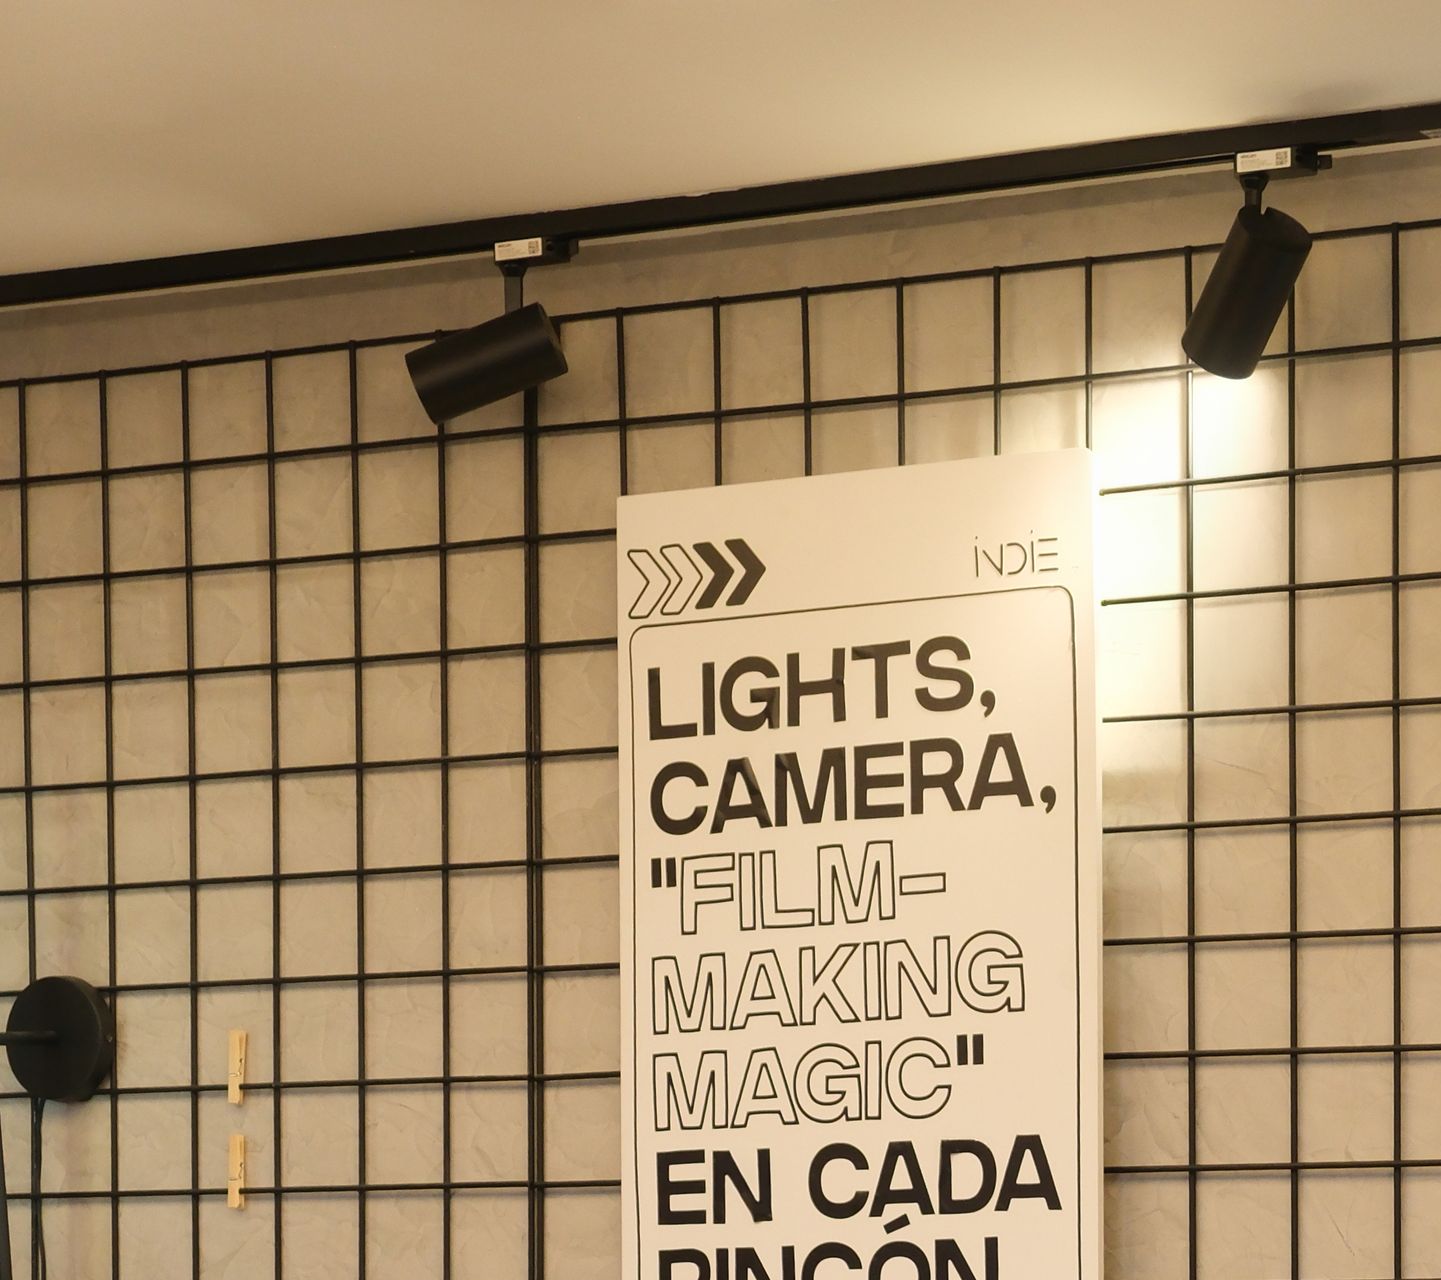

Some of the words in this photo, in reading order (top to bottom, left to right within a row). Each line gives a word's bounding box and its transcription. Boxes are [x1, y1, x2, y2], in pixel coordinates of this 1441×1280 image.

[647, 635, 996, 741] LIGHTS,
[649, 732, 1057, 836] CAMERA,
[651, 929, 1026, 1036] MAKING
[652, 1033, 985, 1132] MAGIC"
[655, 1147, 774, 1226] EN
[807, 1133, 1063, 1219] CADA
